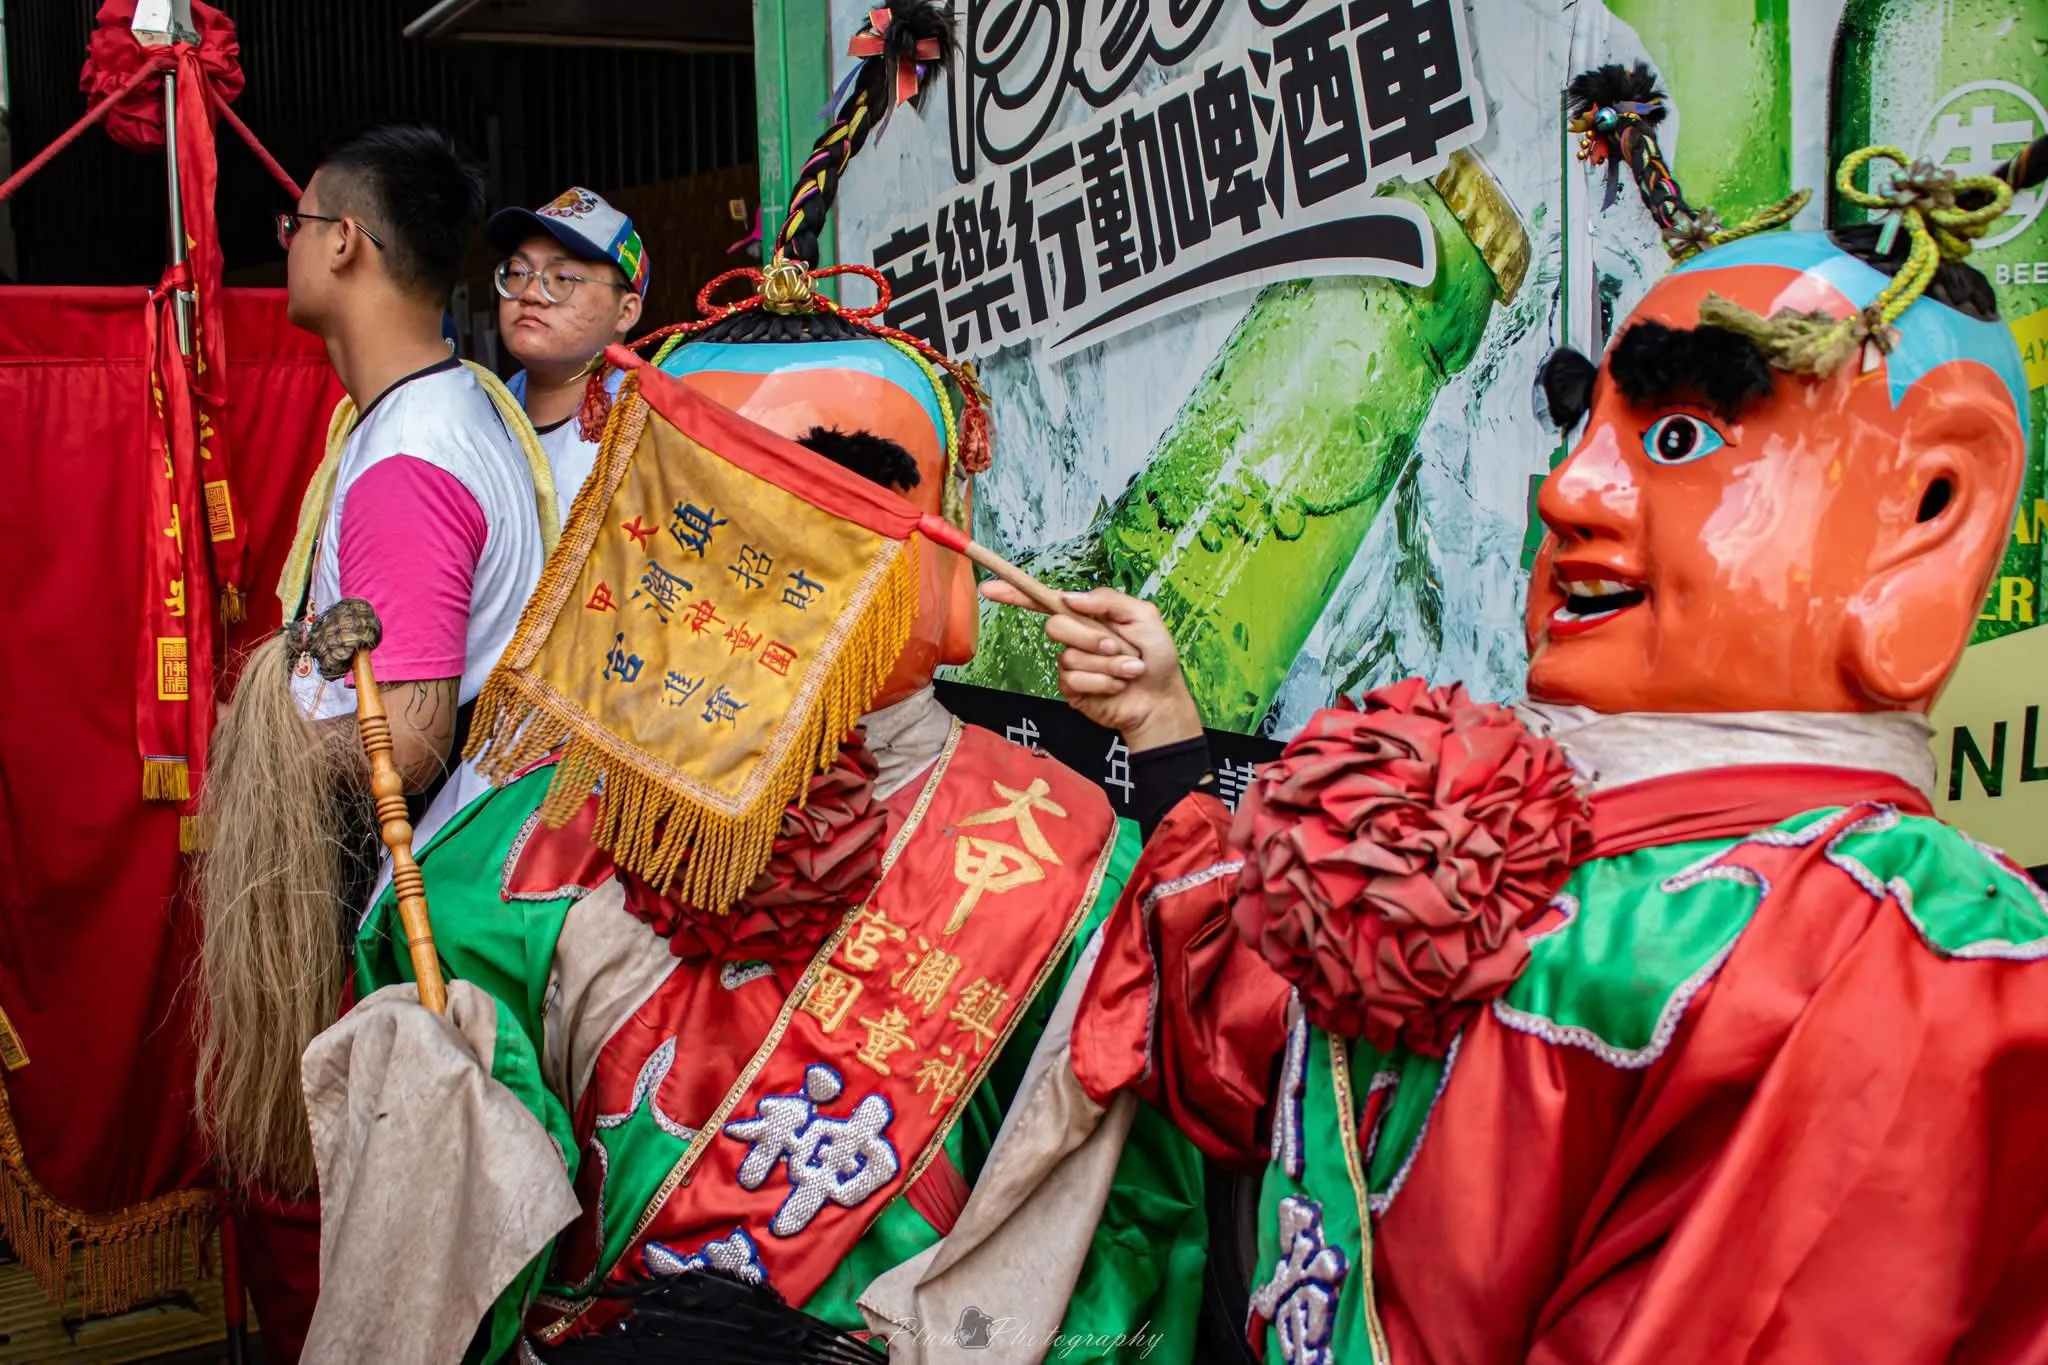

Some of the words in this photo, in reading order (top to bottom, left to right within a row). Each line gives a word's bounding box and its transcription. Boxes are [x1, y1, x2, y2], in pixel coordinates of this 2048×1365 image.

[585, 515, 660, 613] 大甲
[728, 543, 825, 613] 招財
[943, 777, 1068, 937] 大甲
